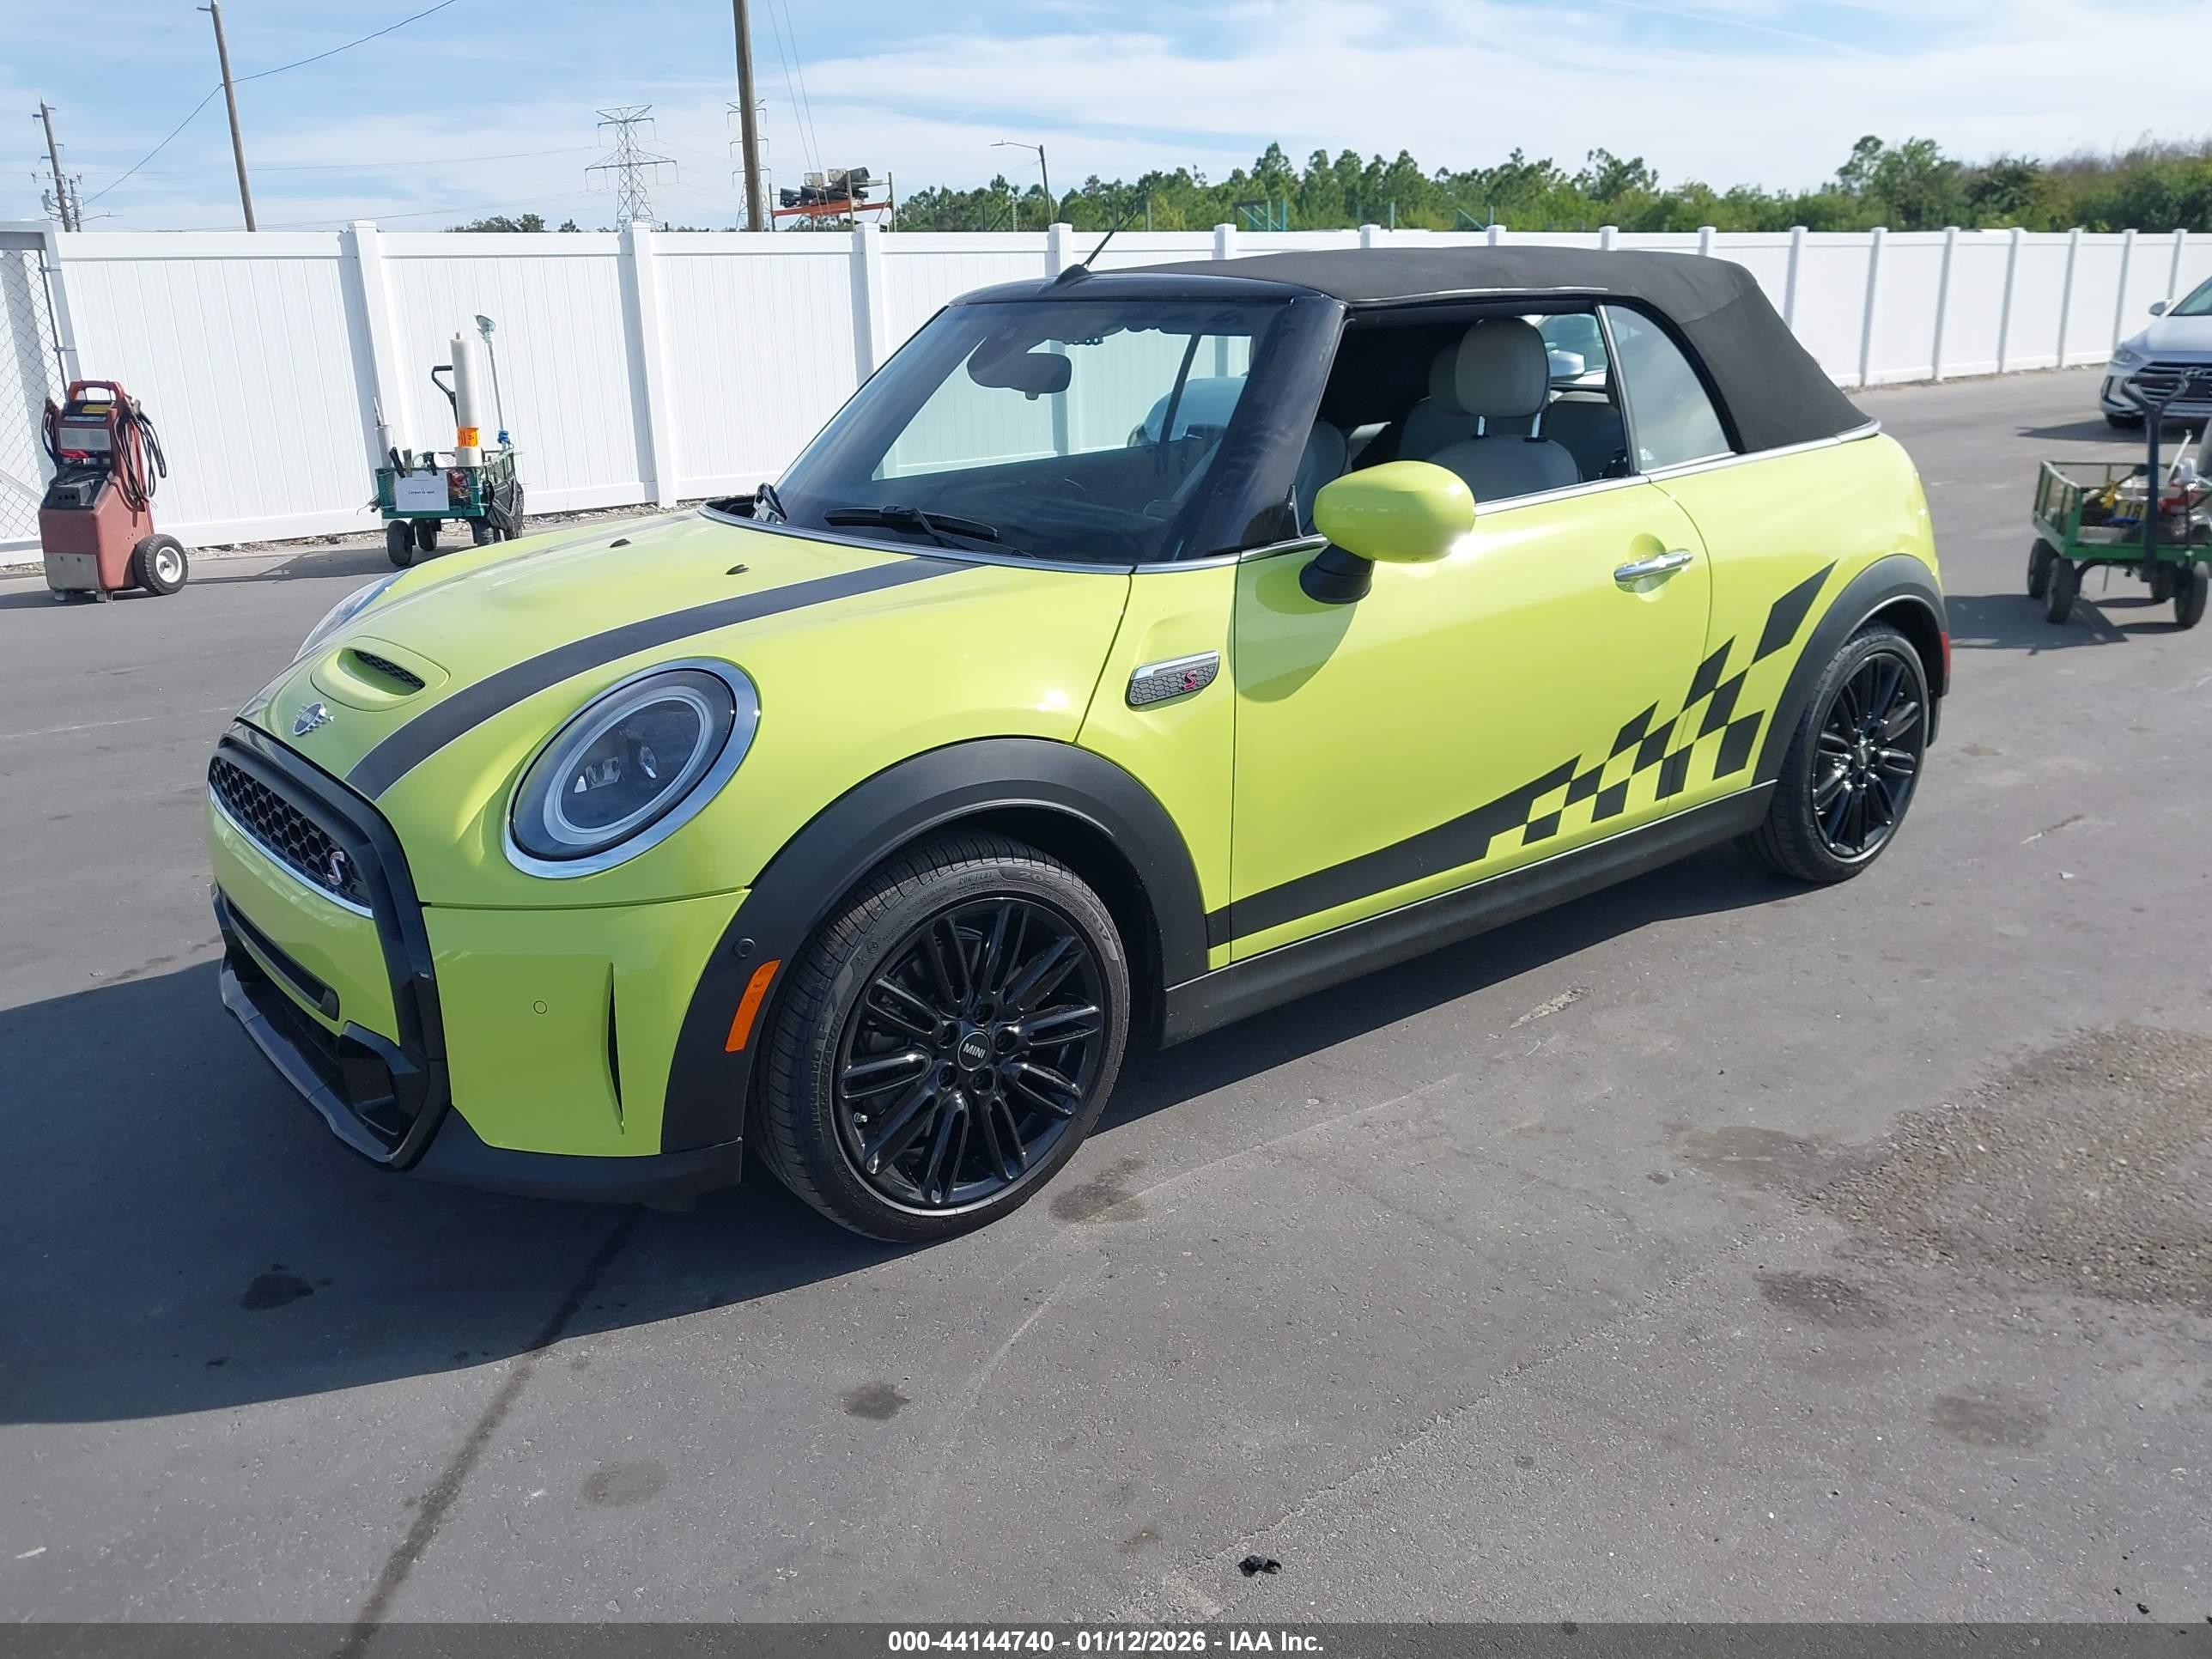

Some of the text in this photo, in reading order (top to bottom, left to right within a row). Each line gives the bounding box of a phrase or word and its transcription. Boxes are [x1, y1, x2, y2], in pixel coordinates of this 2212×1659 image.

[1182, 670, 1197, 690] S
[327, 851, 345, 885] S
[963, 1042, 987, 1059] MINI
